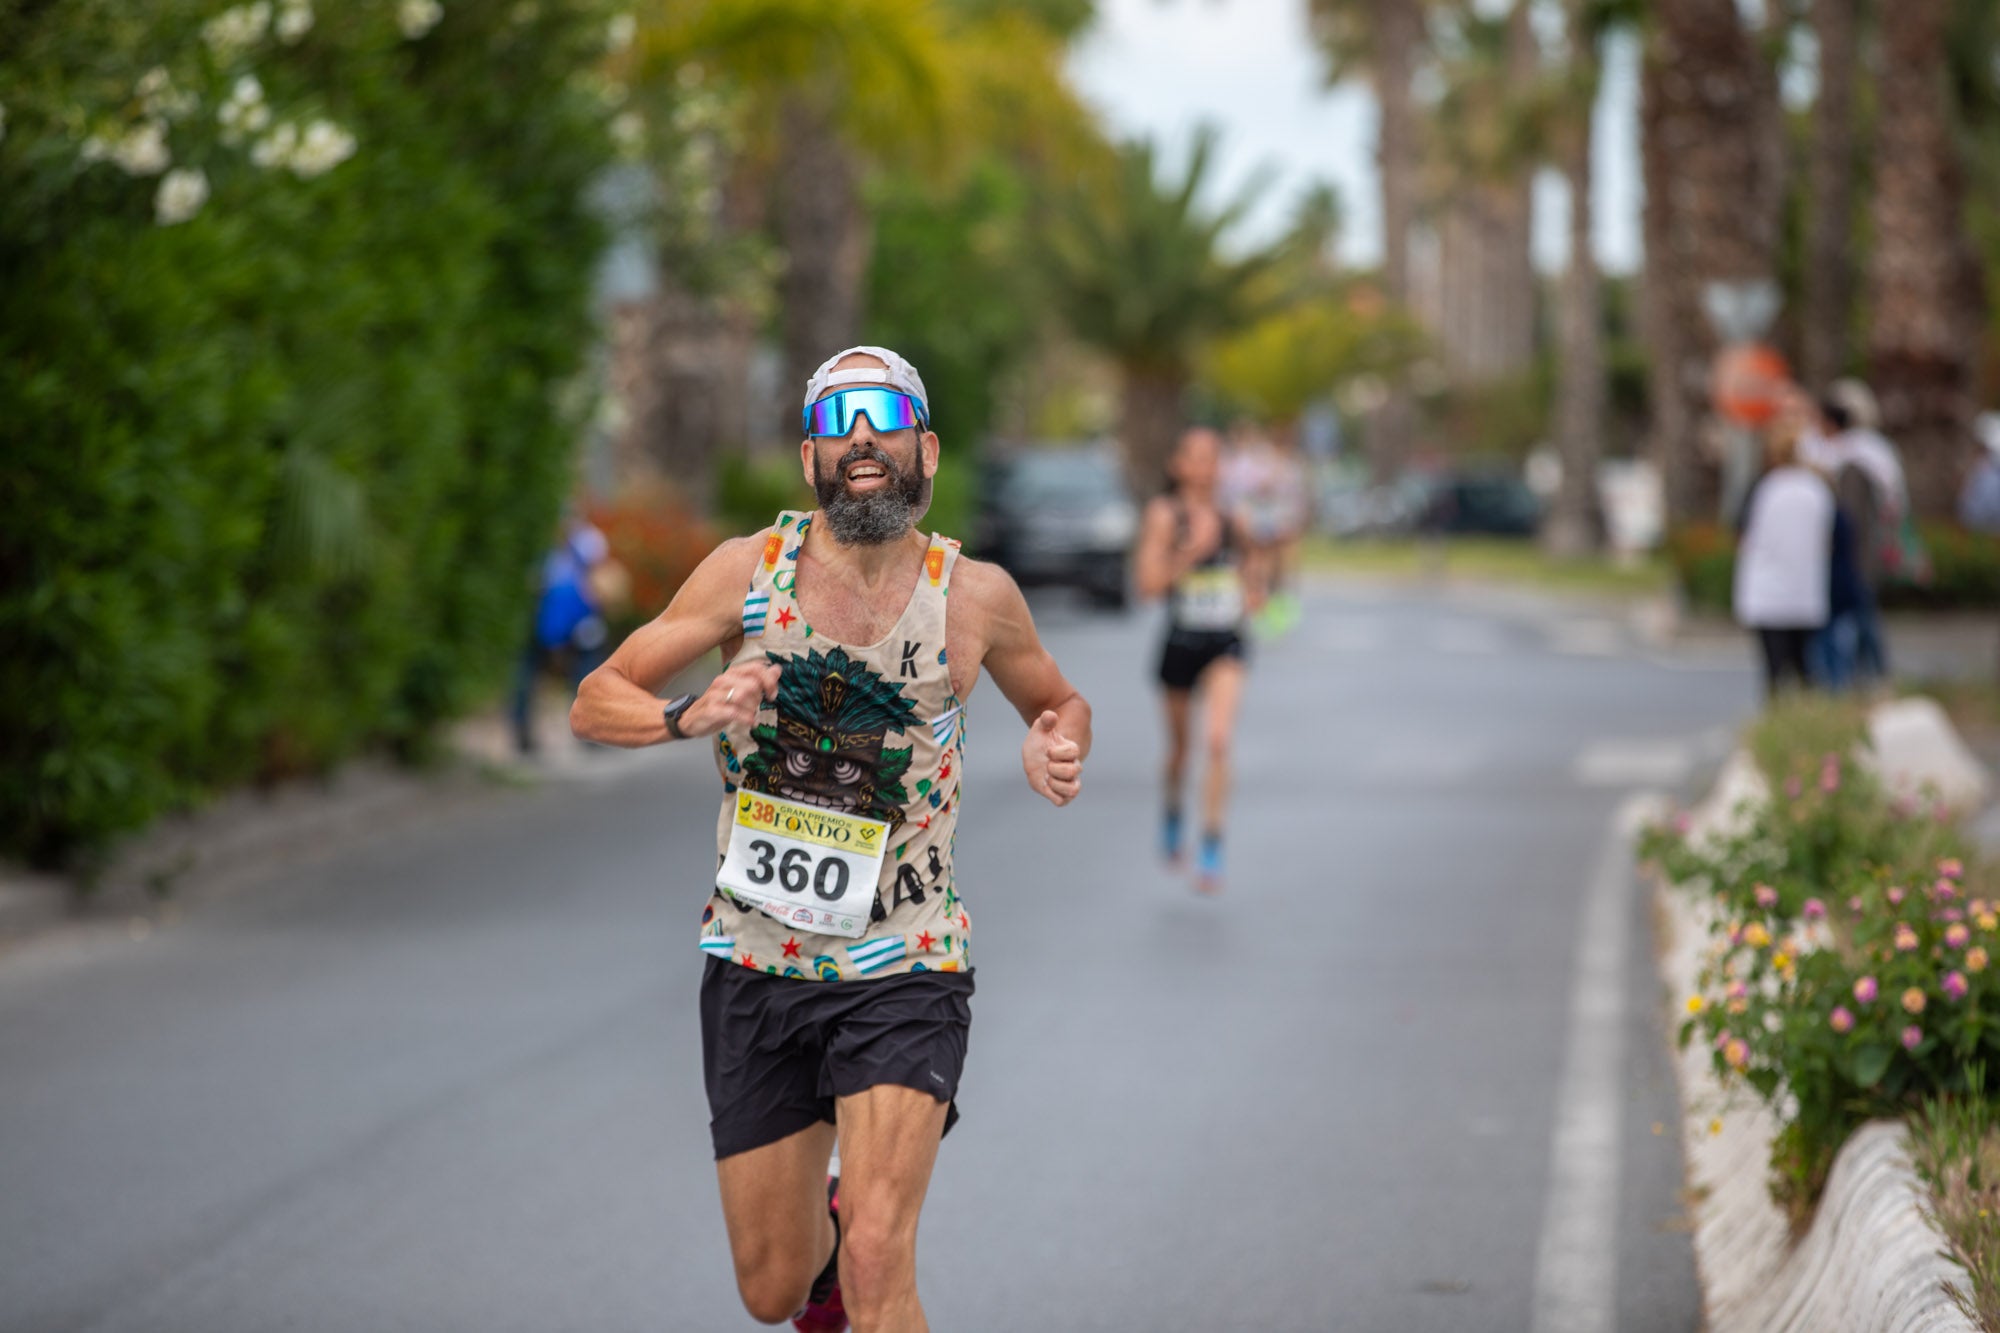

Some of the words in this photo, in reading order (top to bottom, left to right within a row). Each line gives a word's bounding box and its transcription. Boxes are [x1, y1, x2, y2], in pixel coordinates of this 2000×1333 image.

[900, 640, 922, 679] K
[752, 801, 776, 822] 38
[780, 805, 806, 817] GRAN
[808, 813, 846, 828] PREMIO
[774, 813, 850, 842] FONDO
[746, 840, 850, 902] 360
